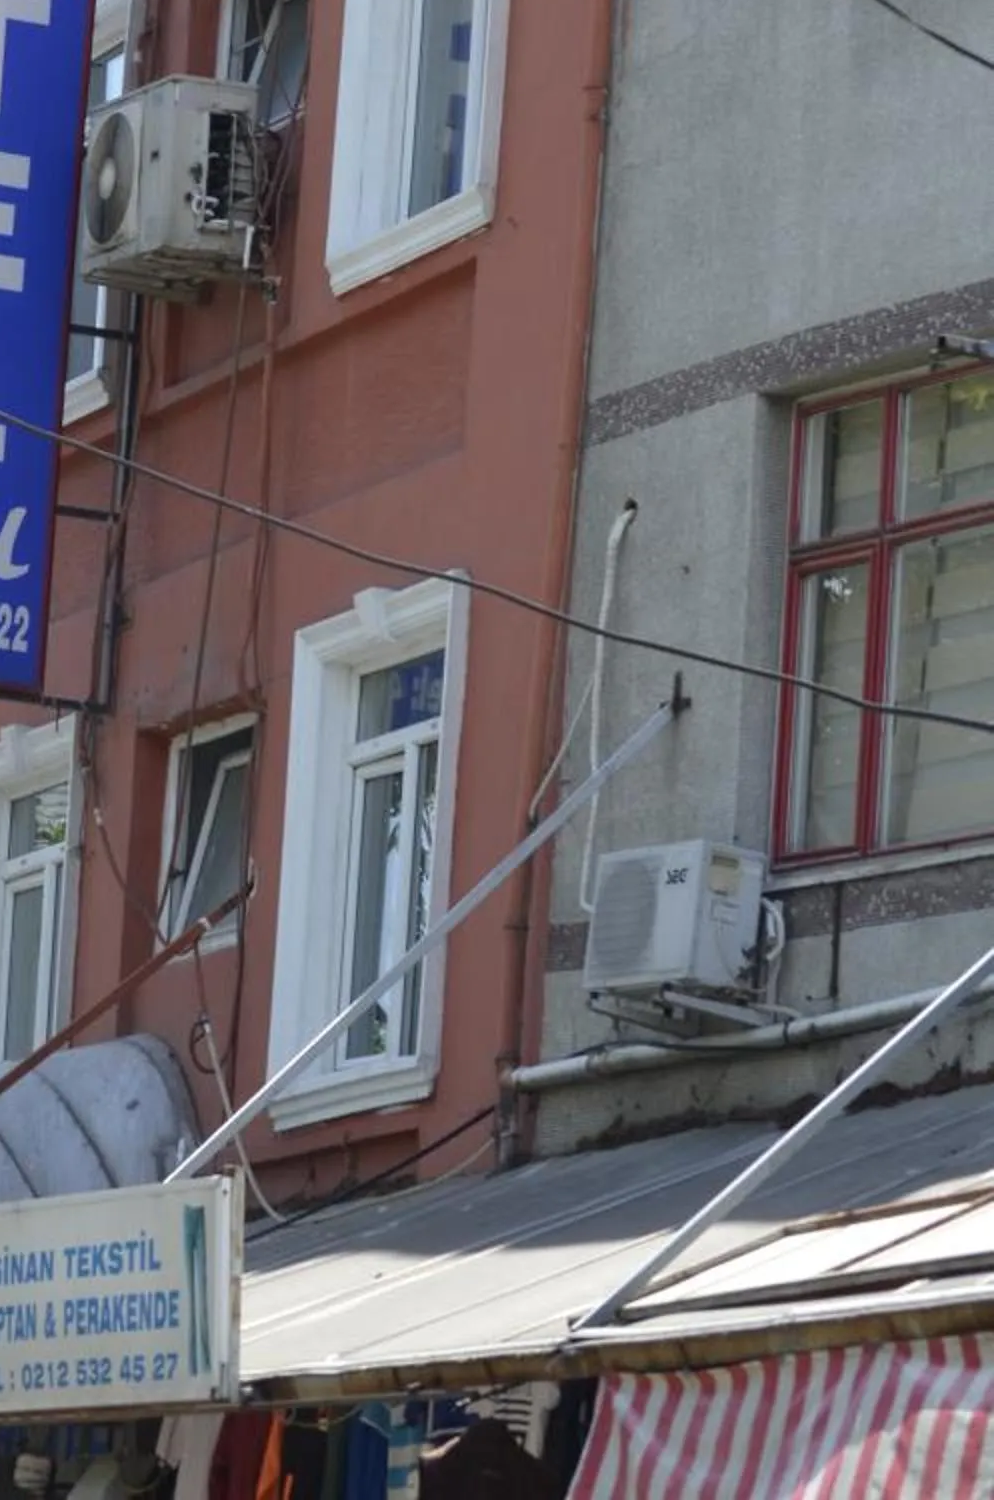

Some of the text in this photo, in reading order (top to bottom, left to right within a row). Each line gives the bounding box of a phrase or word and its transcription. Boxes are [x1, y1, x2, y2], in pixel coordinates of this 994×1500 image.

[64, 1230, 161, 1279] TEKSTİL
[44, 1301, 57, 1340] &
[64, 1289, 180, 1337] PERAKENDE
[21, 1361, 69, 1391] 0212
[75, 1357, 112, 1386] 532
[119, 1354, 146, 1383] 45
[152, 1352, 179, 1381] 27
